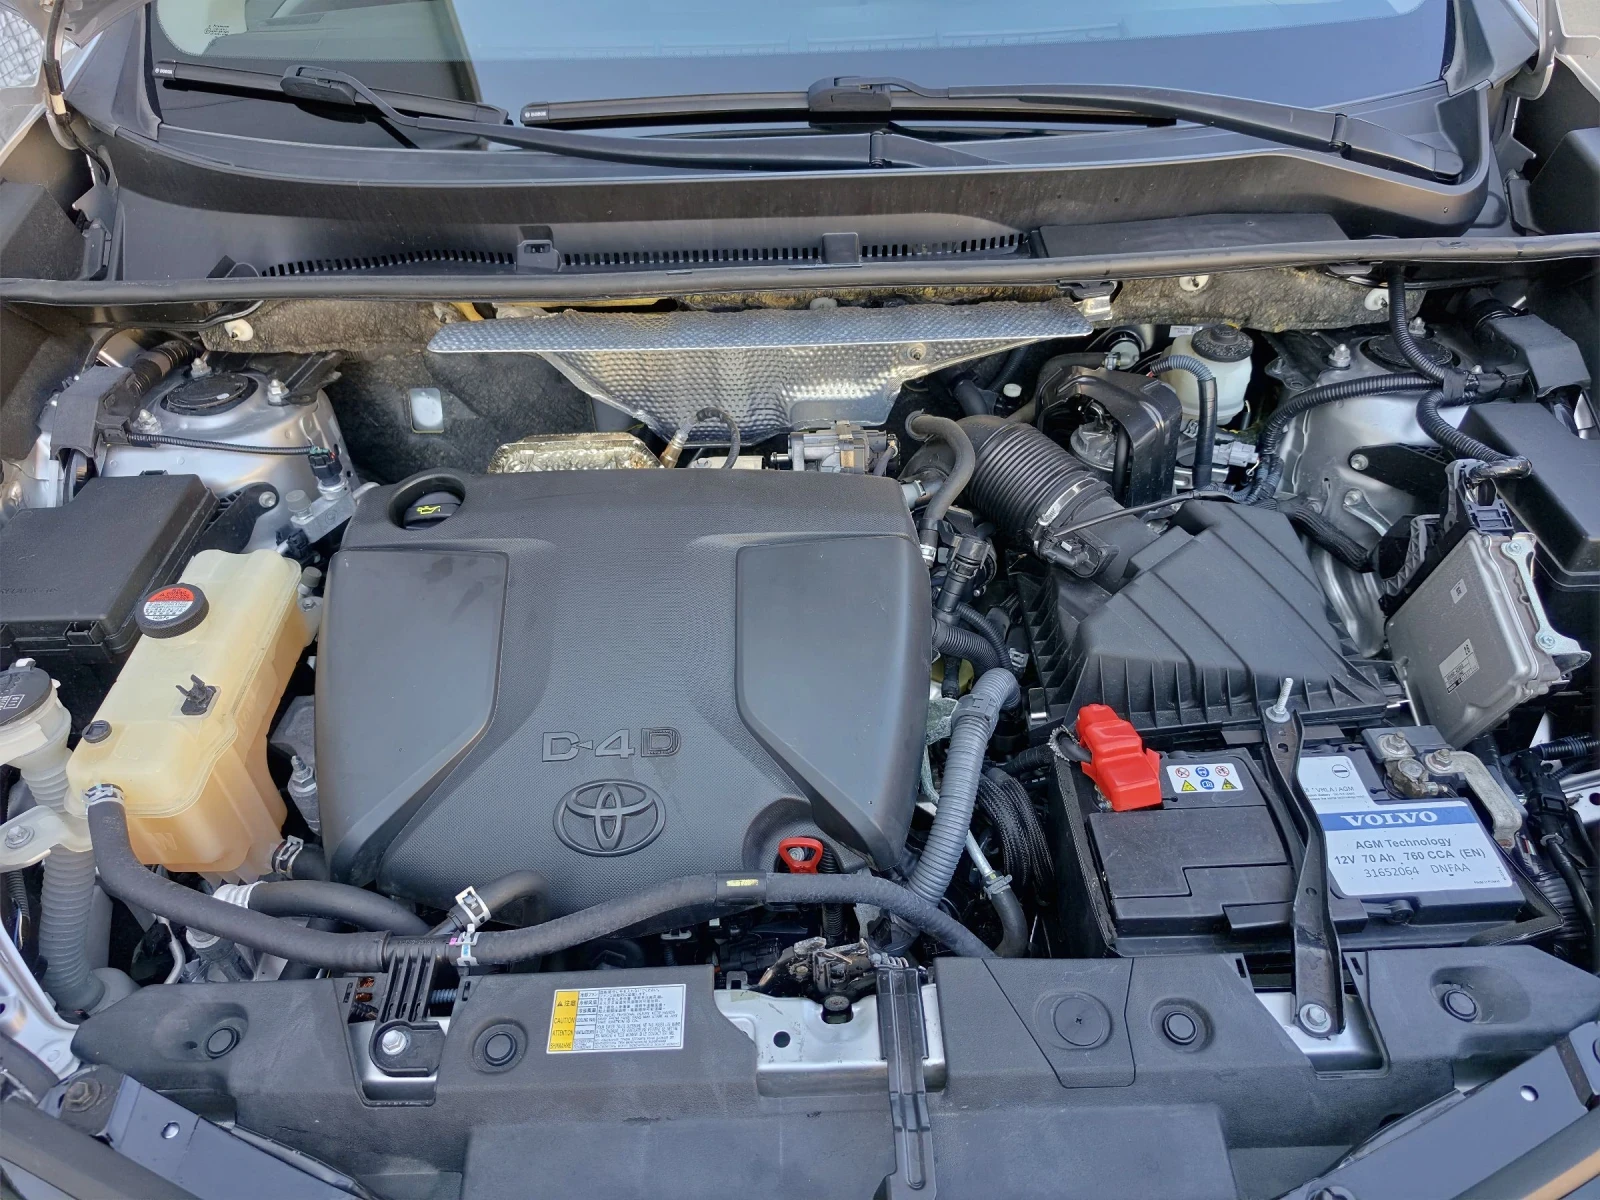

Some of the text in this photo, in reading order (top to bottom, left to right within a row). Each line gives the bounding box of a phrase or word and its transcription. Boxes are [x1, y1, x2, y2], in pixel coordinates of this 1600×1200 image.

[541, 727, 681, 762] D-4D
[1341, 810, 1438, 827] VOLVO
[1356, 837, 1452, 850] AGM Technology
[1334, 847, 1486, 865] 12V 70 Ah 760 CCA (EN)
[1364, 863, 1471, 878] 31652064 DNFAA
[554, 1016, 575, 1024] CAUTION
[552, 1029, 573, 1037] ATTENTION
